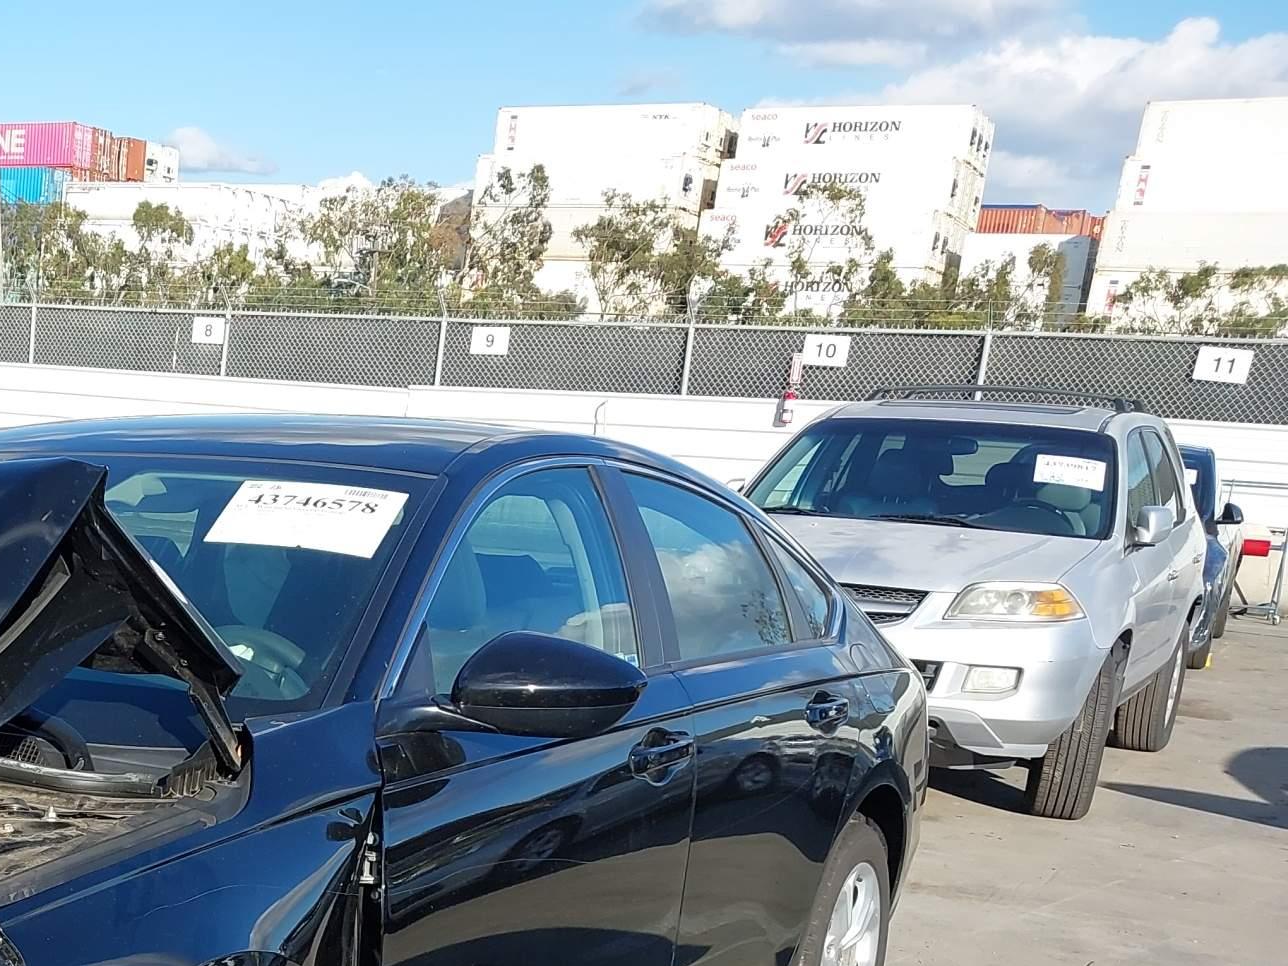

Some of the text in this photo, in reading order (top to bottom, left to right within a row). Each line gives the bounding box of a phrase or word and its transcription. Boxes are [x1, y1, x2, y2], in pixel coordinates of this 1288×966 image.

[751, 112, 779, 121] seaco
[831, 120, 902, 133] HORIZON
[828, 133, 890, 141] LINES
[729, 163, 758, 172] seaco
[811, 172, 881, 184] HORIZON
[792, 224, 862, 236] HORIZON
[784, 280, 853, 293] HORIZON
[205, 324, 213, 337] 8
[486, 334, 495, 348] 9
[816, 342, 837, 358] 10
[1213, 357, 1236, 374] 11
[247, 492, 380, 515] 43746578
